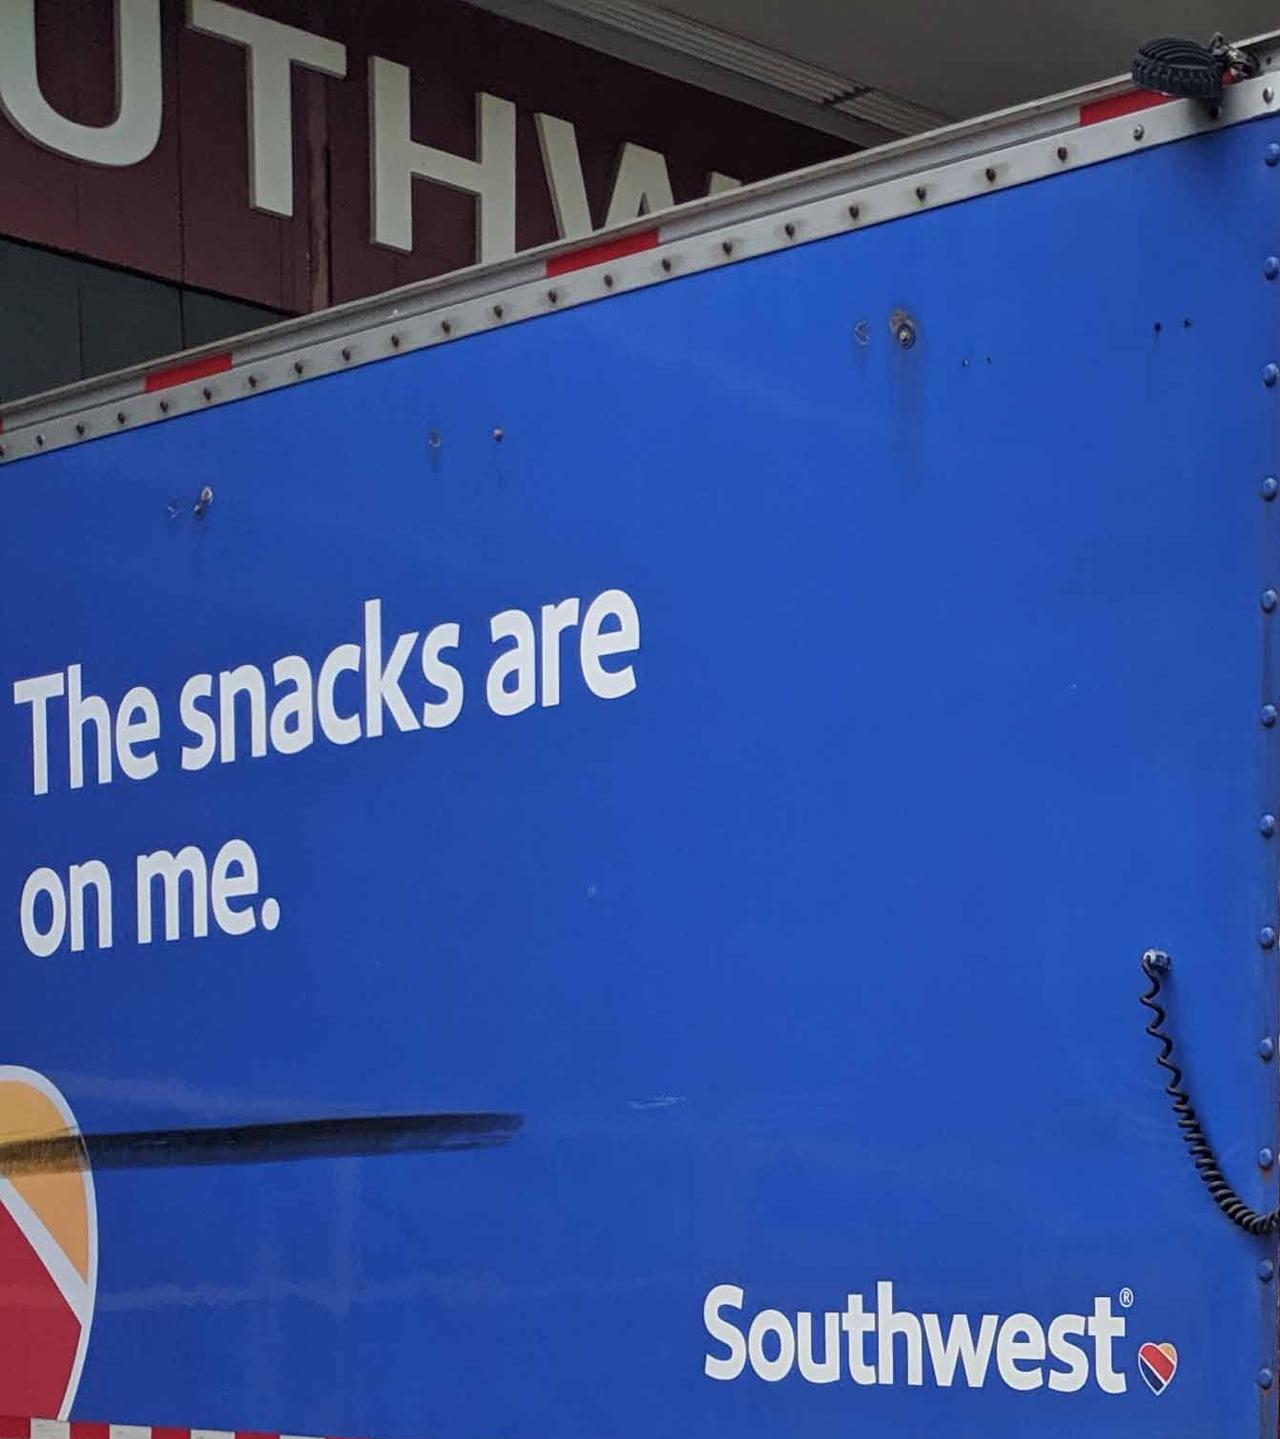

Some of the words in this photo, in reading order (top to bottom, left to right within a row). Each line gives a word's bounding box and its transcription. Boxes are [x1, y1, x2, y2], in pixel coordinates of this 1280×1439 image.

[13, 662, 162, 796] The
[179, 598, 465, 772] snacks
[486, 588, 641, 717] are
[20, 859, 113, 957] on
[136, 838, 281, 945] me.
